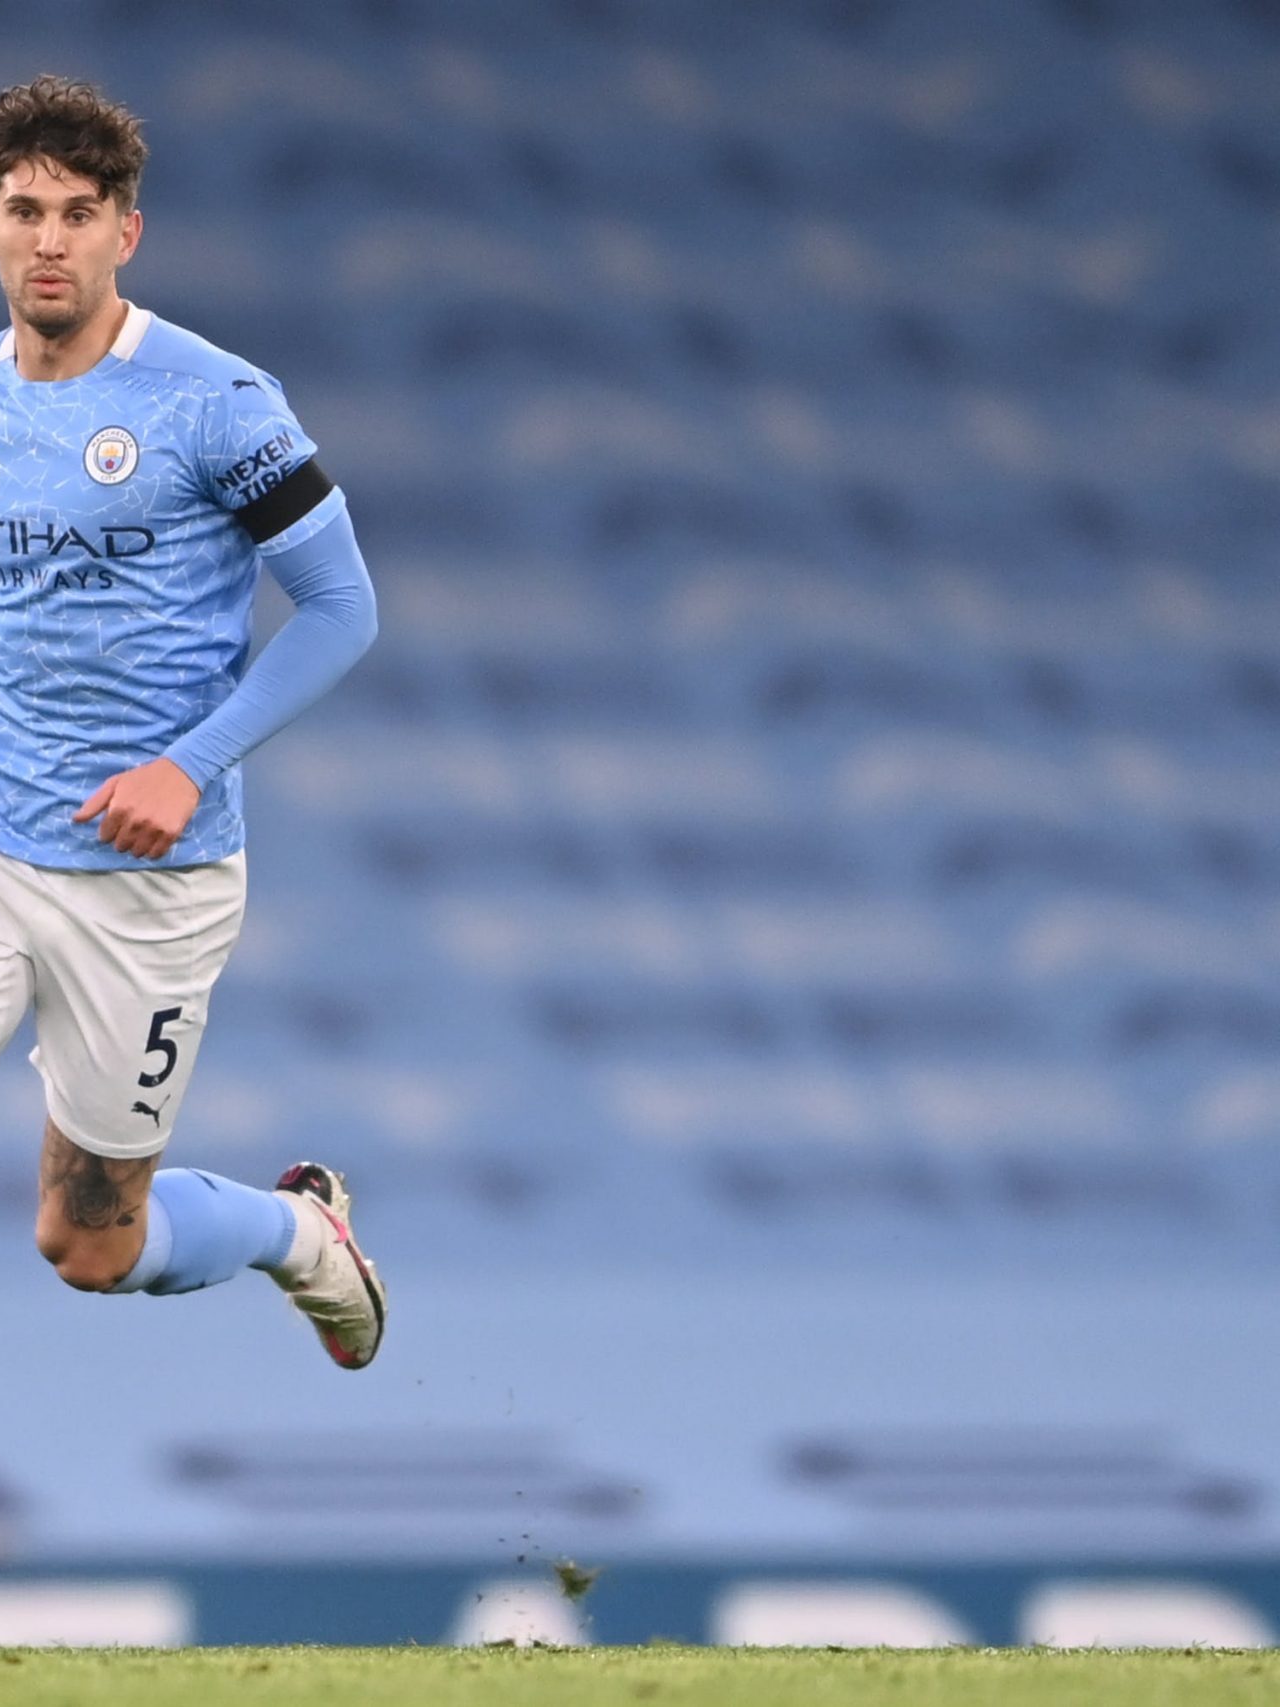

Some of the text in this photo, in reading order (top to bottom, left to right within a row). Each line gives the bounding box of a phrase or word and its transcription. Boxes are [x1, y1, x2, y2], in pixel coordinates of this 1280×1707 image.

[91, 430, 134, 449] MANCHESTER
[215, 430, 294, 490] NEXEN
[138, 1005, 183, 1088] 5
